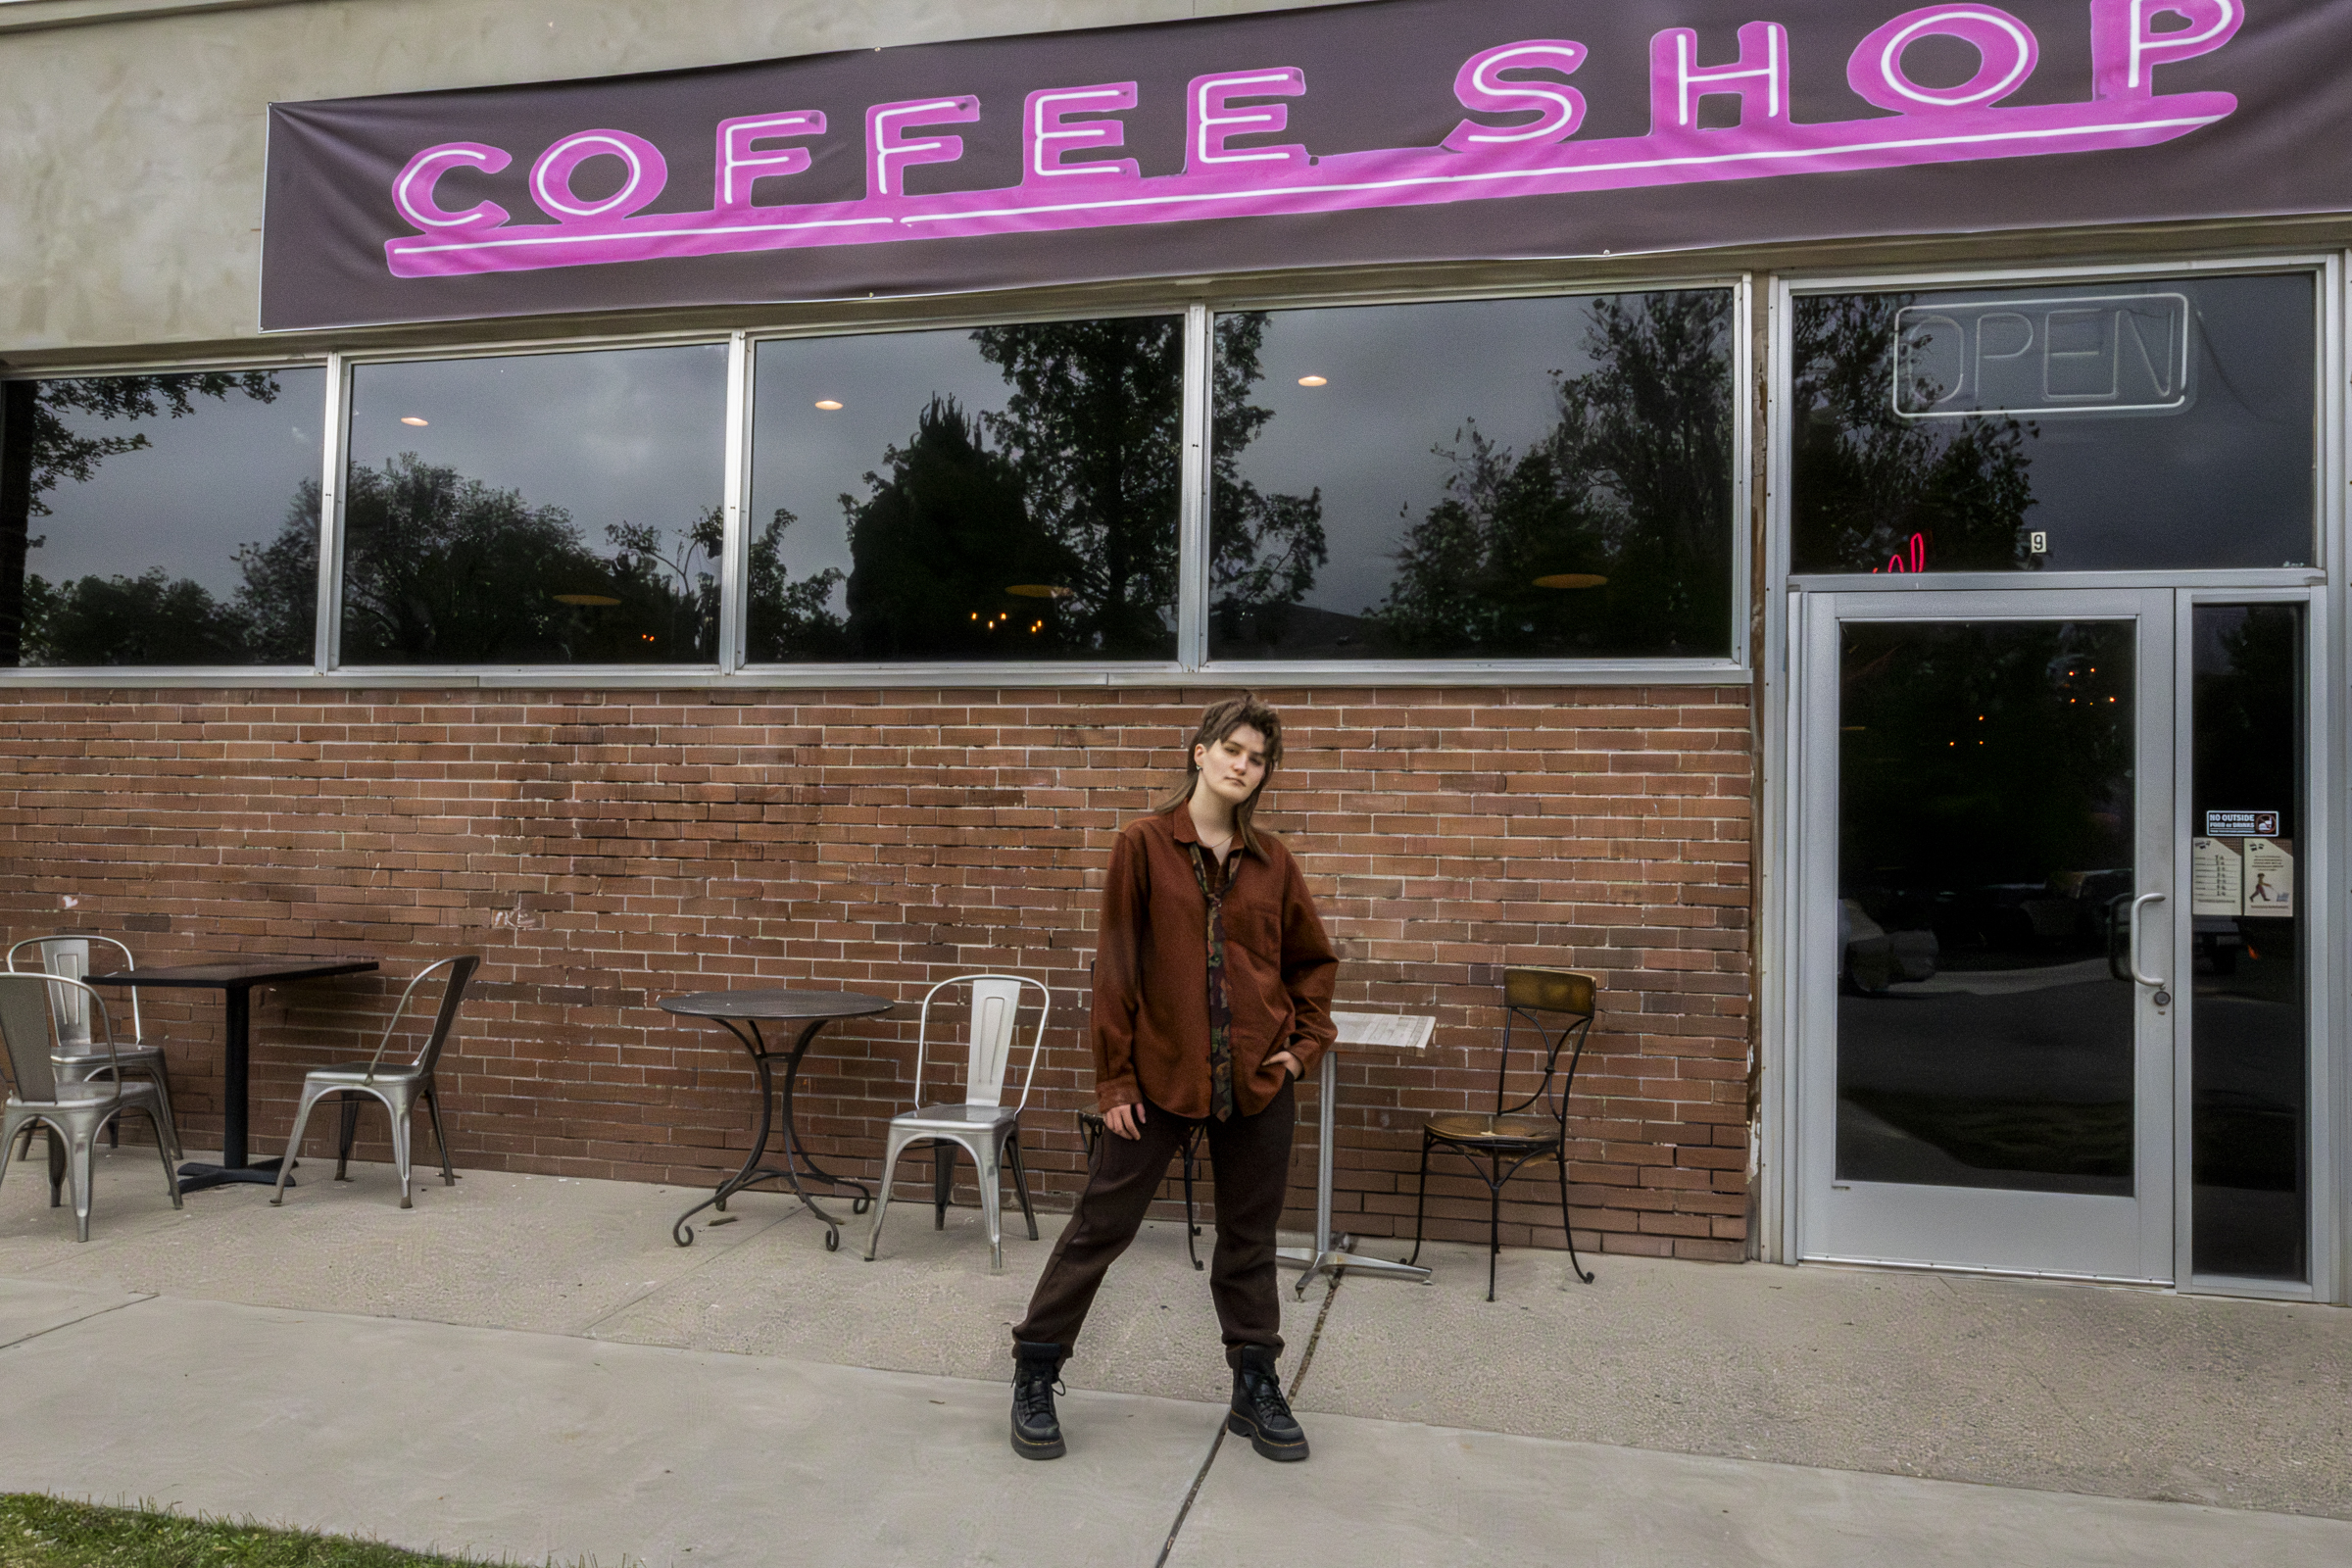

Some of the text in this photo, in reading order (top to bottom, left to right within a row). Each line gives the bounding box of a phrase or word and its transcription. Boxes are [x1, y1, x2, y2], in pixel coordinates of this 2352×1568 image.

[391, 0, 2245, 234] COFFEE SHOP
[1906, 306, 2176, 405] OPEN
[2034, 534, 2043, 551] 9
